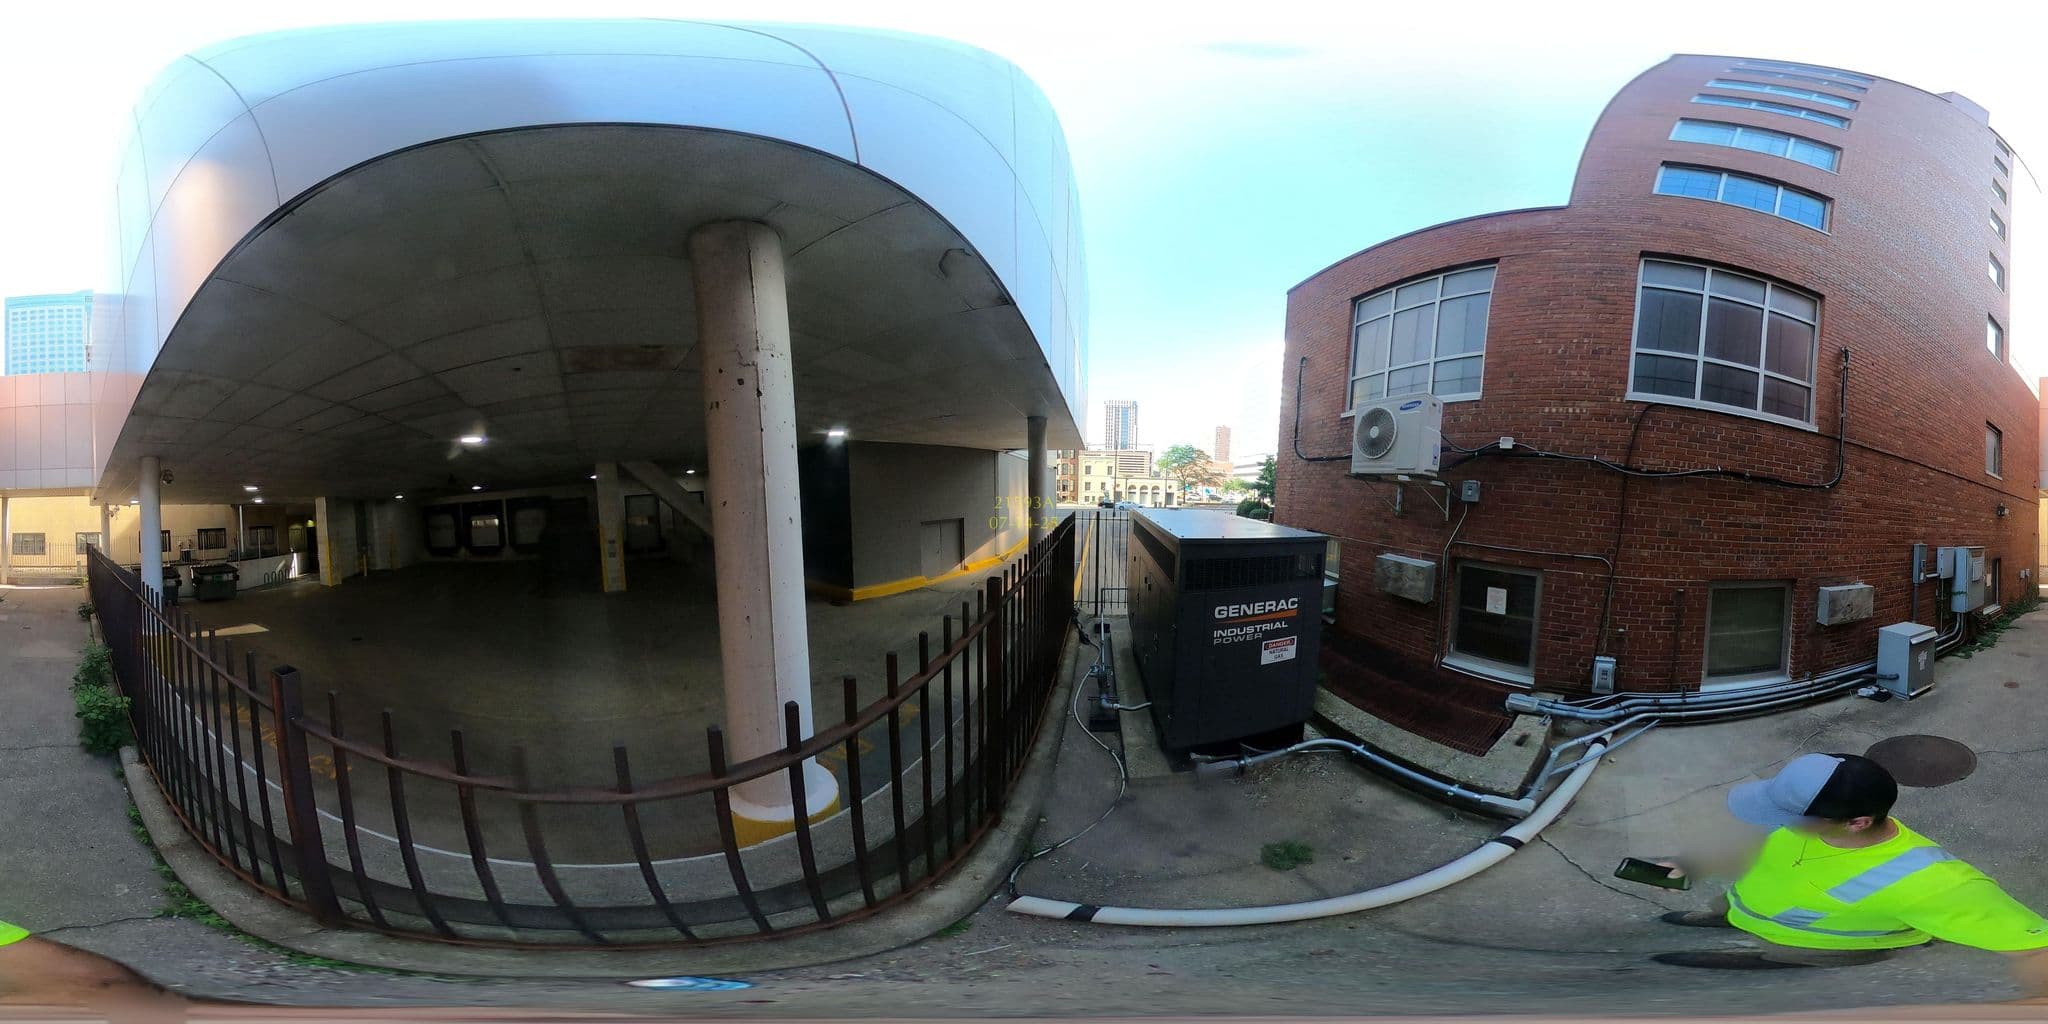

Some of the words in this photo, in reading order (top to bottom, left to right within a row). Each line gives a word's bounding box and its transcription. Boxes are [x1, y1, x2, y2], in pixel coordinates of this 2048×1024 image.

[1214, 598, 1298, 618] GENERAC
[1213, 621, 1288, 637] INDUSTRIAL
[1213, 633, 1262, 645] POWER
[1268, 639, 1292, 648] DANGER
